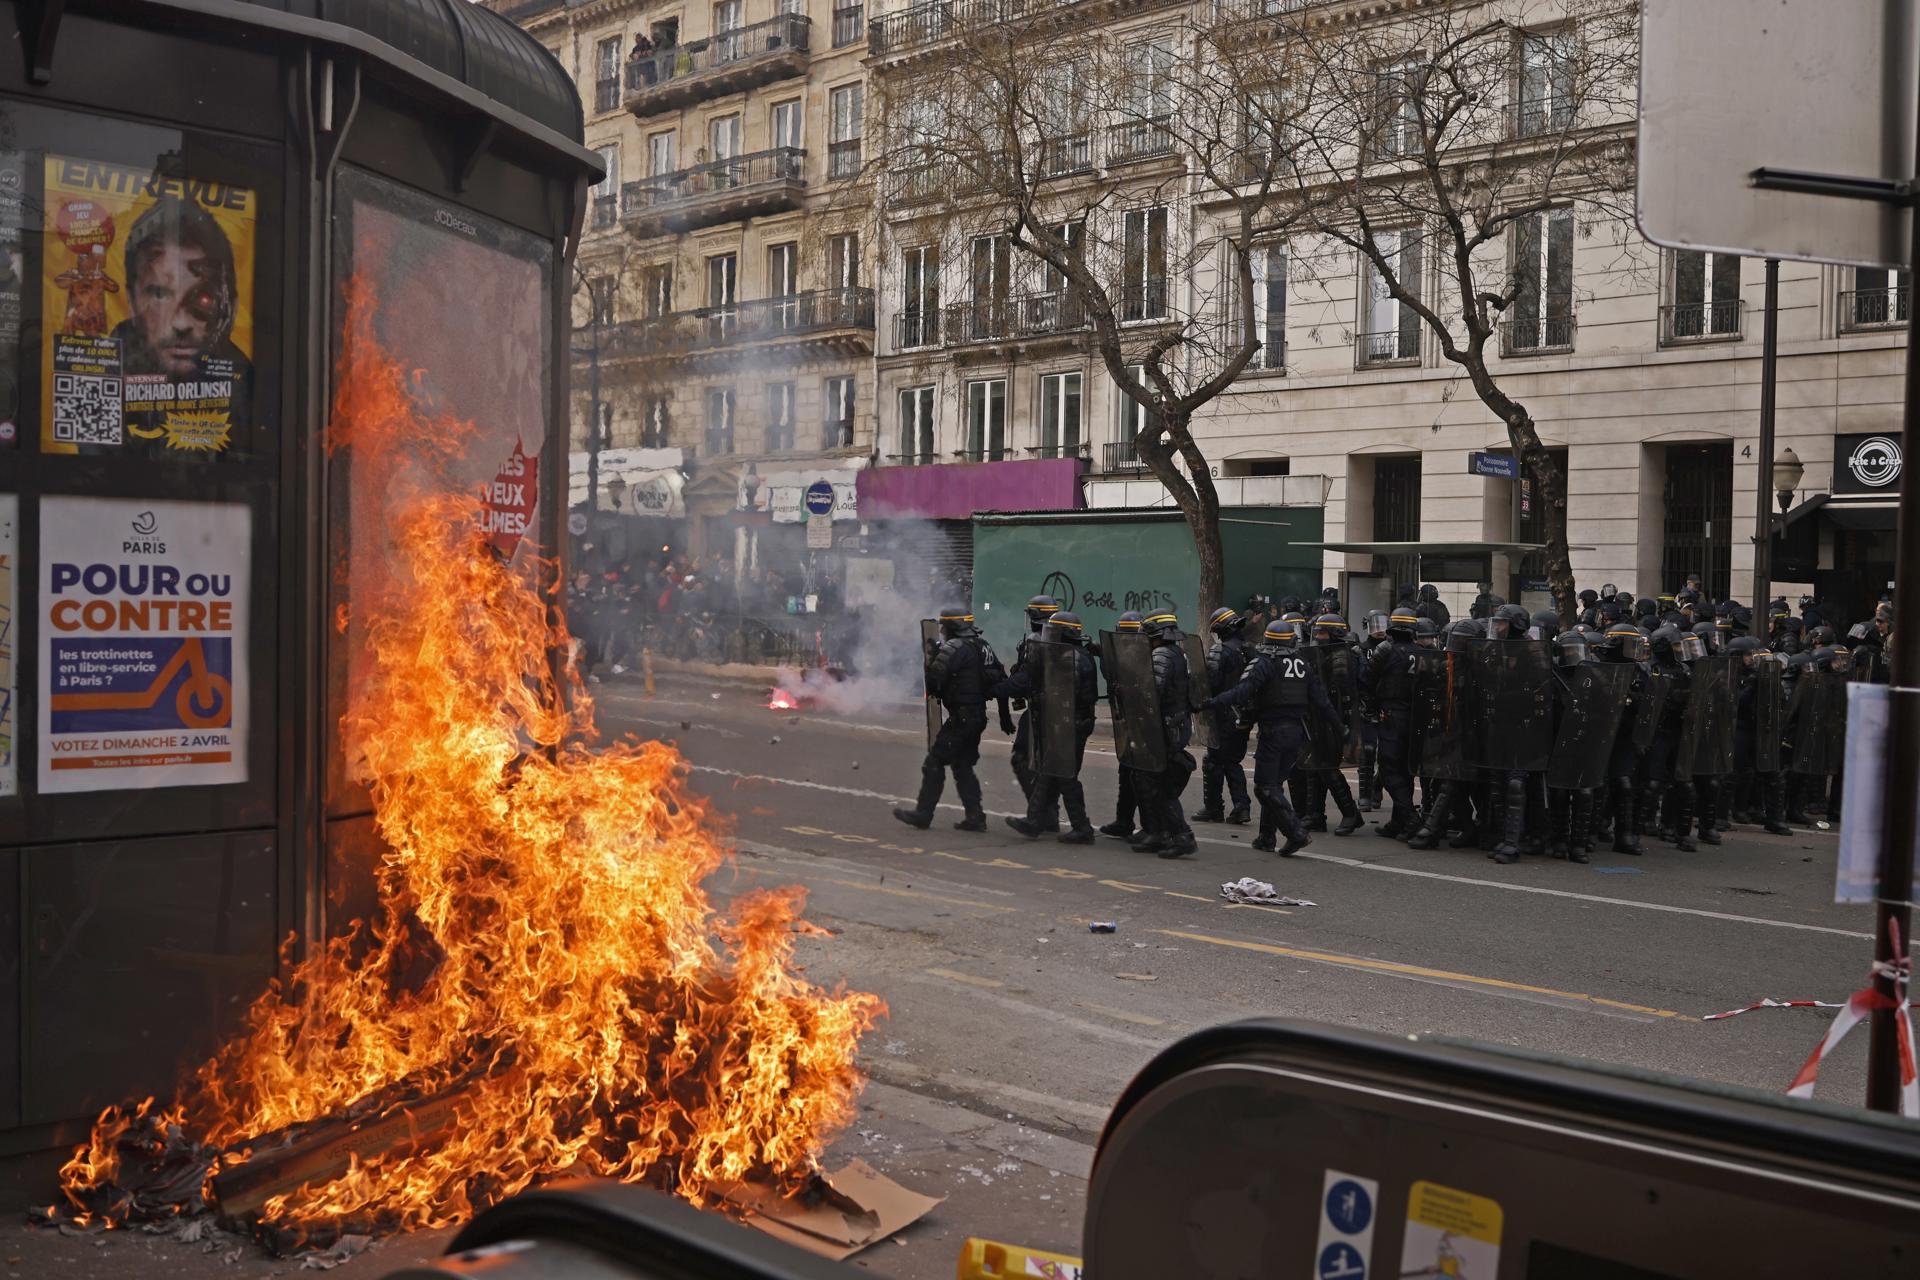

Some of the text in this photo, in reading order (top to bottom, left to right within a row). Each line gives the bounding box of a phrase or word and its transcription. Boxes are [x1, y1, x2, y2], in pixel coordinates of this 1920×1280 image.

[61, 159, 248, 210] ENTREVUE
[126, 375, 166, 383] INTERVIEW
[126, 381, 231, 401] RICHARD ORLINSKI
[1741, 445, 1752, 459] 4
[1211, 466, 1218, 478] 6
[122, 541, 167, 554] PARIS
[51, 563, 231, 597] POUR OU
[50, 599, 232, 631] CONTRE
[59, 649, 153, 660] les trottinettes
[59, 661, 157, 673] en libre-service
[1282, 657, 1306, 679] 2C
[59, 675, 113, 686] à Paris ?
[51, 735, 230, 752] VOTEZ DIMANCHE 2 AVRIL
